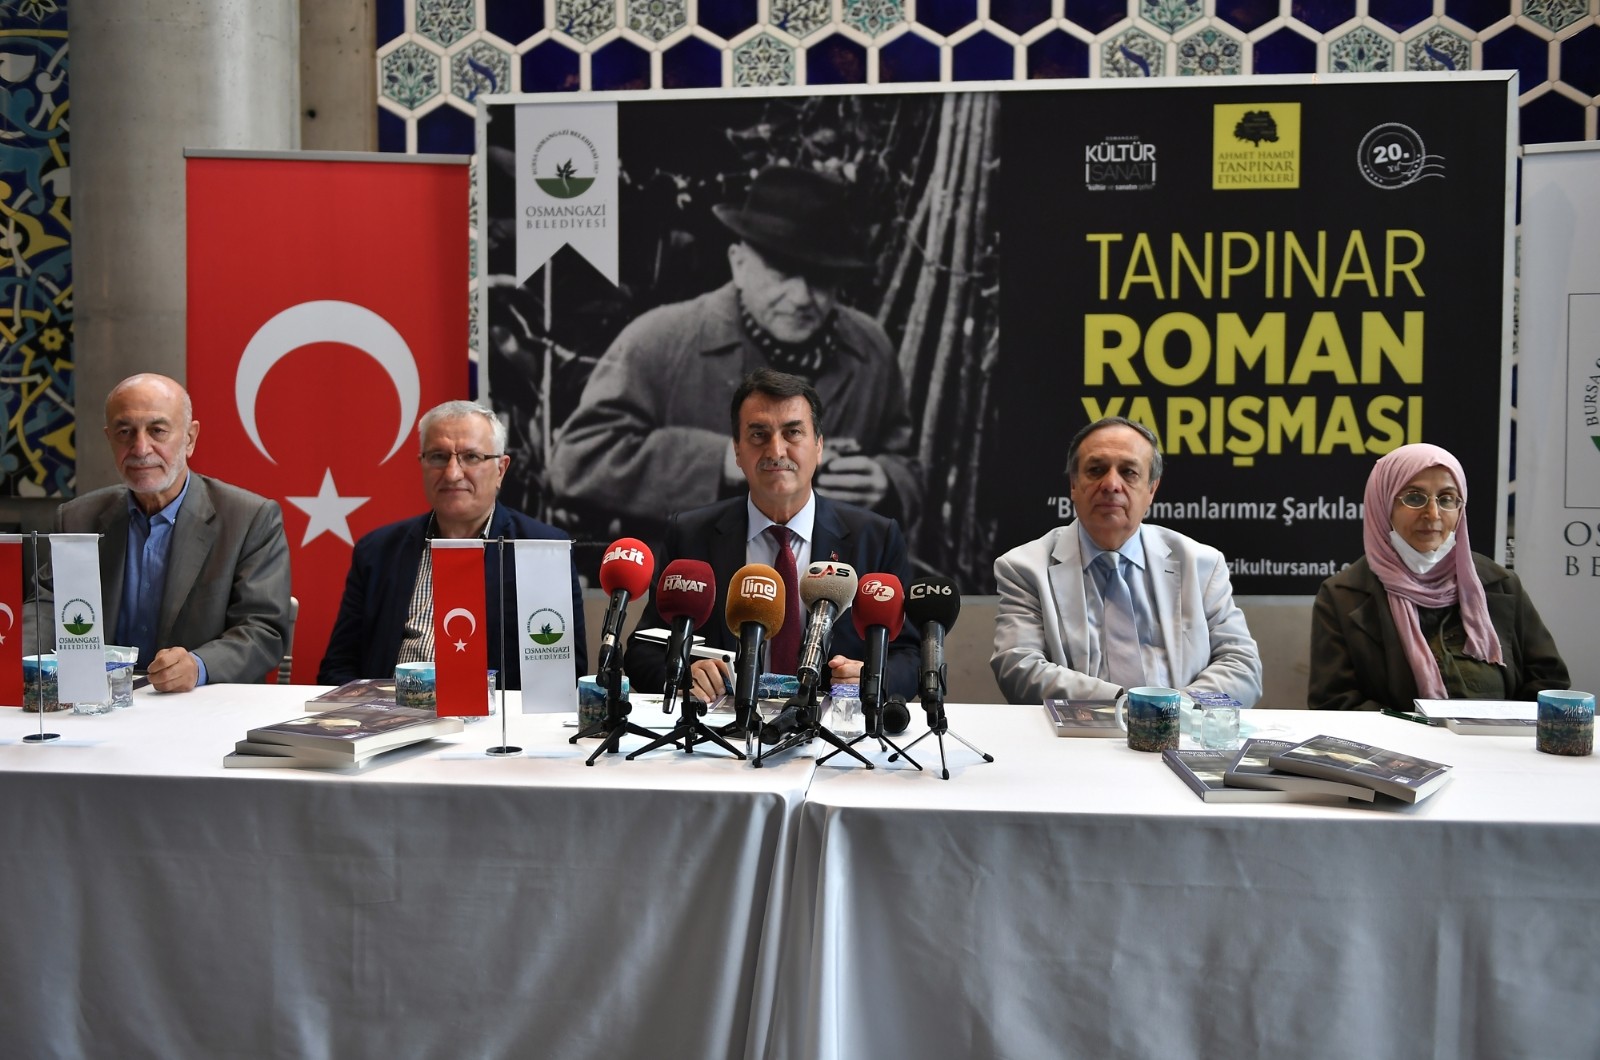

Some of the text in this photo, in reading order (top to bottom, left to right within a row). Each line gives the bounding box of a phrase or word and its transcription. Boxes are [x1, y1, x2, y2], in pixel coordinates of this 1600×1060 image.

[1085, 141, 1156, 162] KÜLTÜR
[1218, 149, 1295, 160] AHMET HAMDİ
[1373, 143, 1410, 164] 20.
[1091, 163, 1151, 181] SANAT
[1218, 161, 1295, 173] TANPINAR
[1218, 173, 1295, 184] ETKİNLİKLERİ
[525, 204, 606, 217] OSMANGAZİ
[526, 218, 606, 229] BELEDİYESİ
[1086, 229, 1426, 300] TANPINAR
[1083, 311, 1424, 386] ROMAN
[1584, 376, 1600, 426] BURSA
[1144, 496, 1277, 519] manlarımız
[602, 547, 645, 565] akit
[663, 578, 708, 592] HAYAT
[744, 578, 775, 598] line
